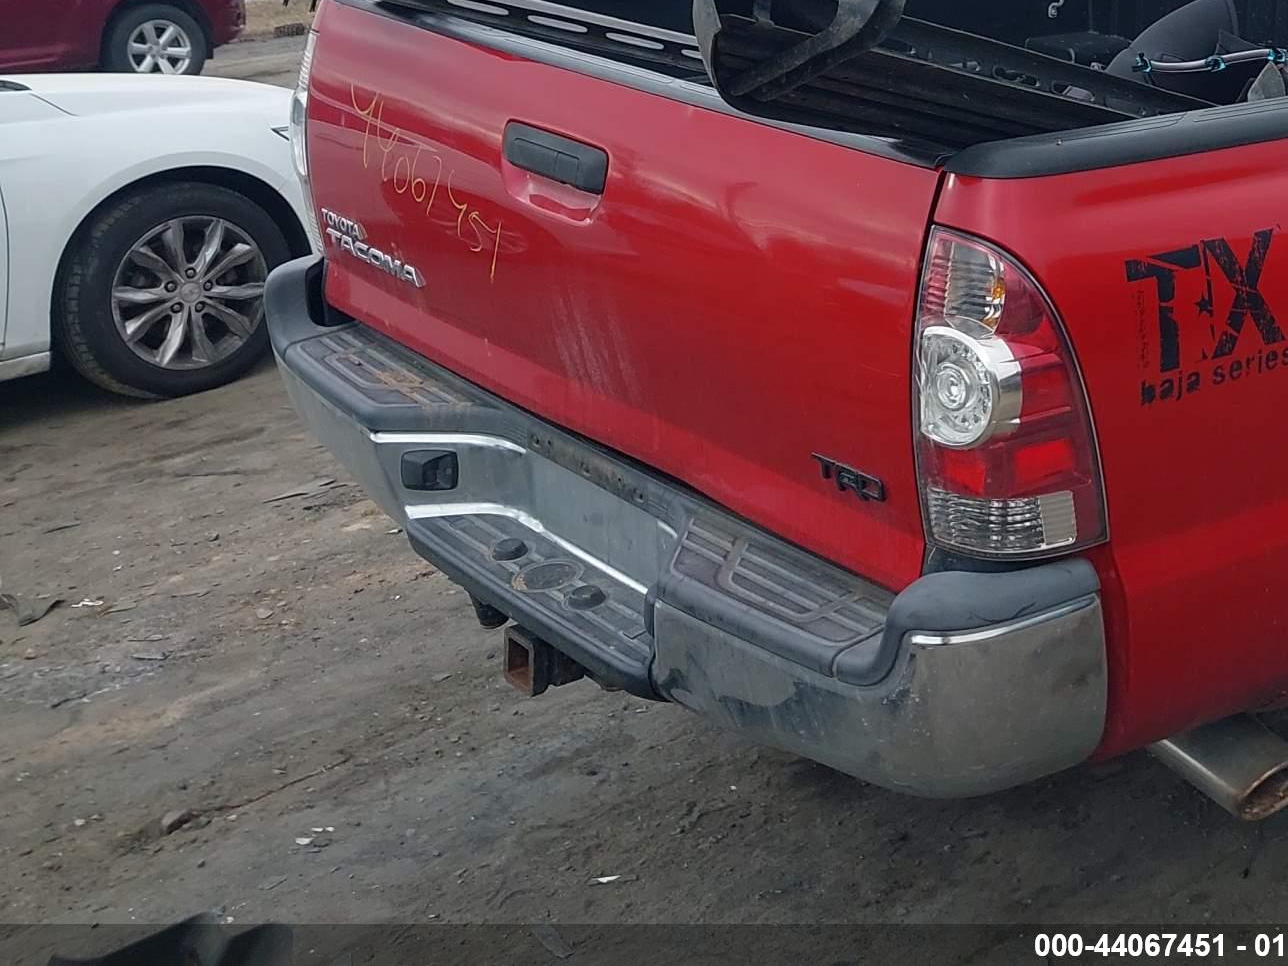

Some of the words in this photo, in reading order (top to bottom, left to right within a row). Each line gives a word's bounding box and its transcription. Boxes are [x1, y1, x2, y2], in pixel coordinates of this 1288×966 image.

[321, 207, 368, 240] TOYOTA
[326, 227, 426, 288] TACOMA
[1140, 371, 1201, 406] baja
[810, 451, 887, 502] TRD
